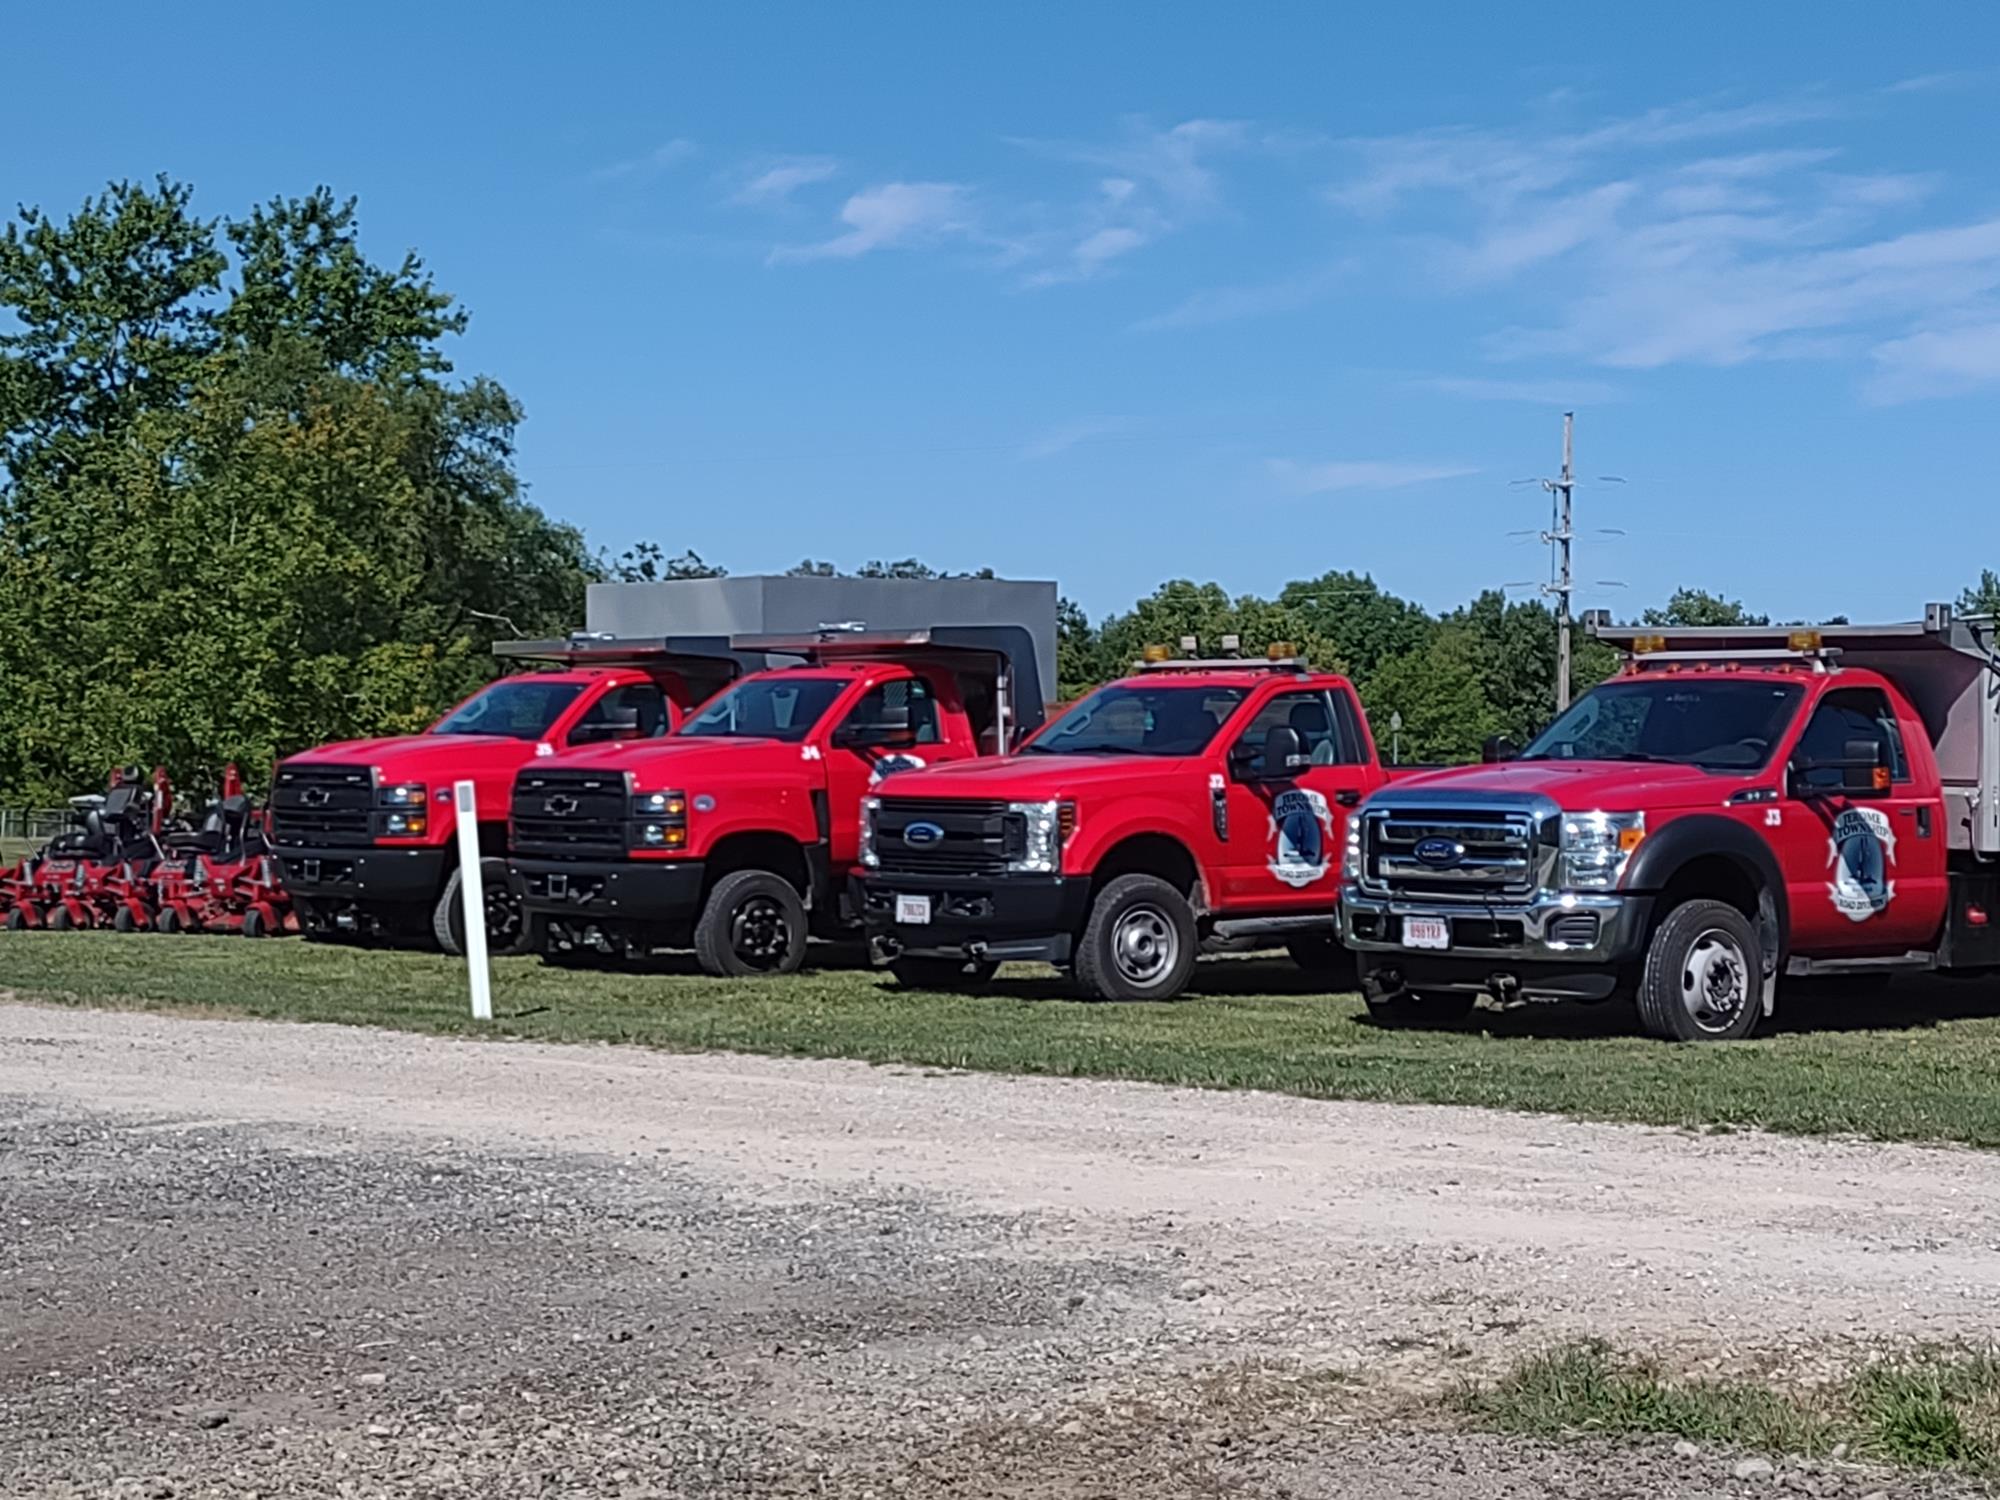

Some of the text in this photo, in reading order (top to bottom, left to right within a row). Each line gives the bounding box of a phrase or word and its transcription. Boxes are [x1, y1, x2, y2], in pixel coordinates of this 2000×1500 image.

[1281, 791, 1318, 804] JEROME
[1276, 801, 1327, 816] TOWNSHIP
[1843, 810, 1881, 825] JEROME
[1837, 822, 1889, 838] TOWNSHIP
